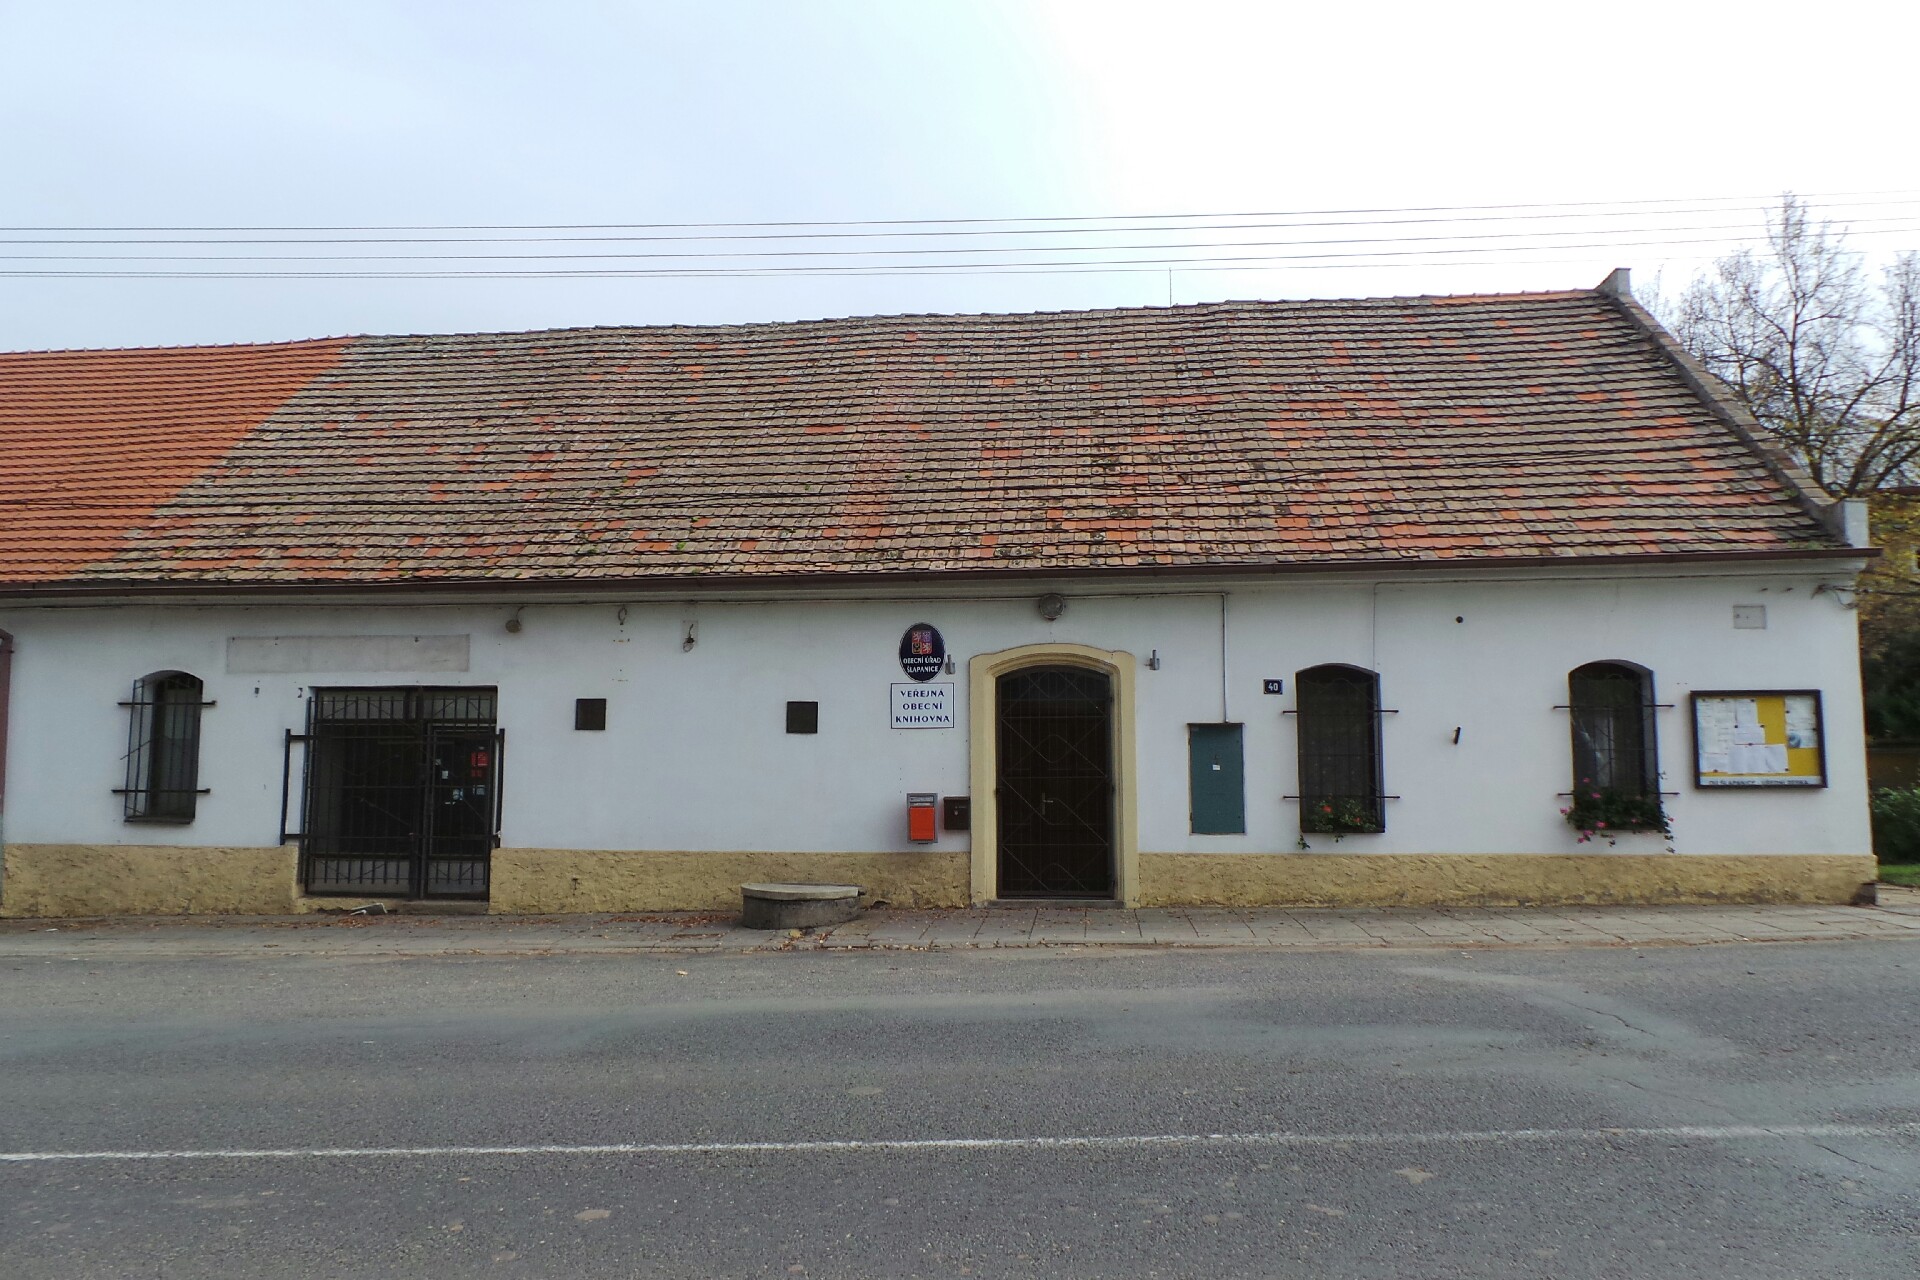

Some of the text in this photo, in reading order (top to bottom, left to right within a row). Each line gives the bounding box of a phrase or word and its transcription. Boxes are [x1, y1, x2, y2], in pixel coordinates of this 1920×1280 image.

[903, 656, 942, 664] OBECNÍ ÚŘAD
[906, 665, 939, 673] ŠLAPANICE
[1268, 682, 1278, 691] 40
[900, 688, 944, 698] VEŘEJNÁ
[902, 701, 943, 710] OBECNÍ
